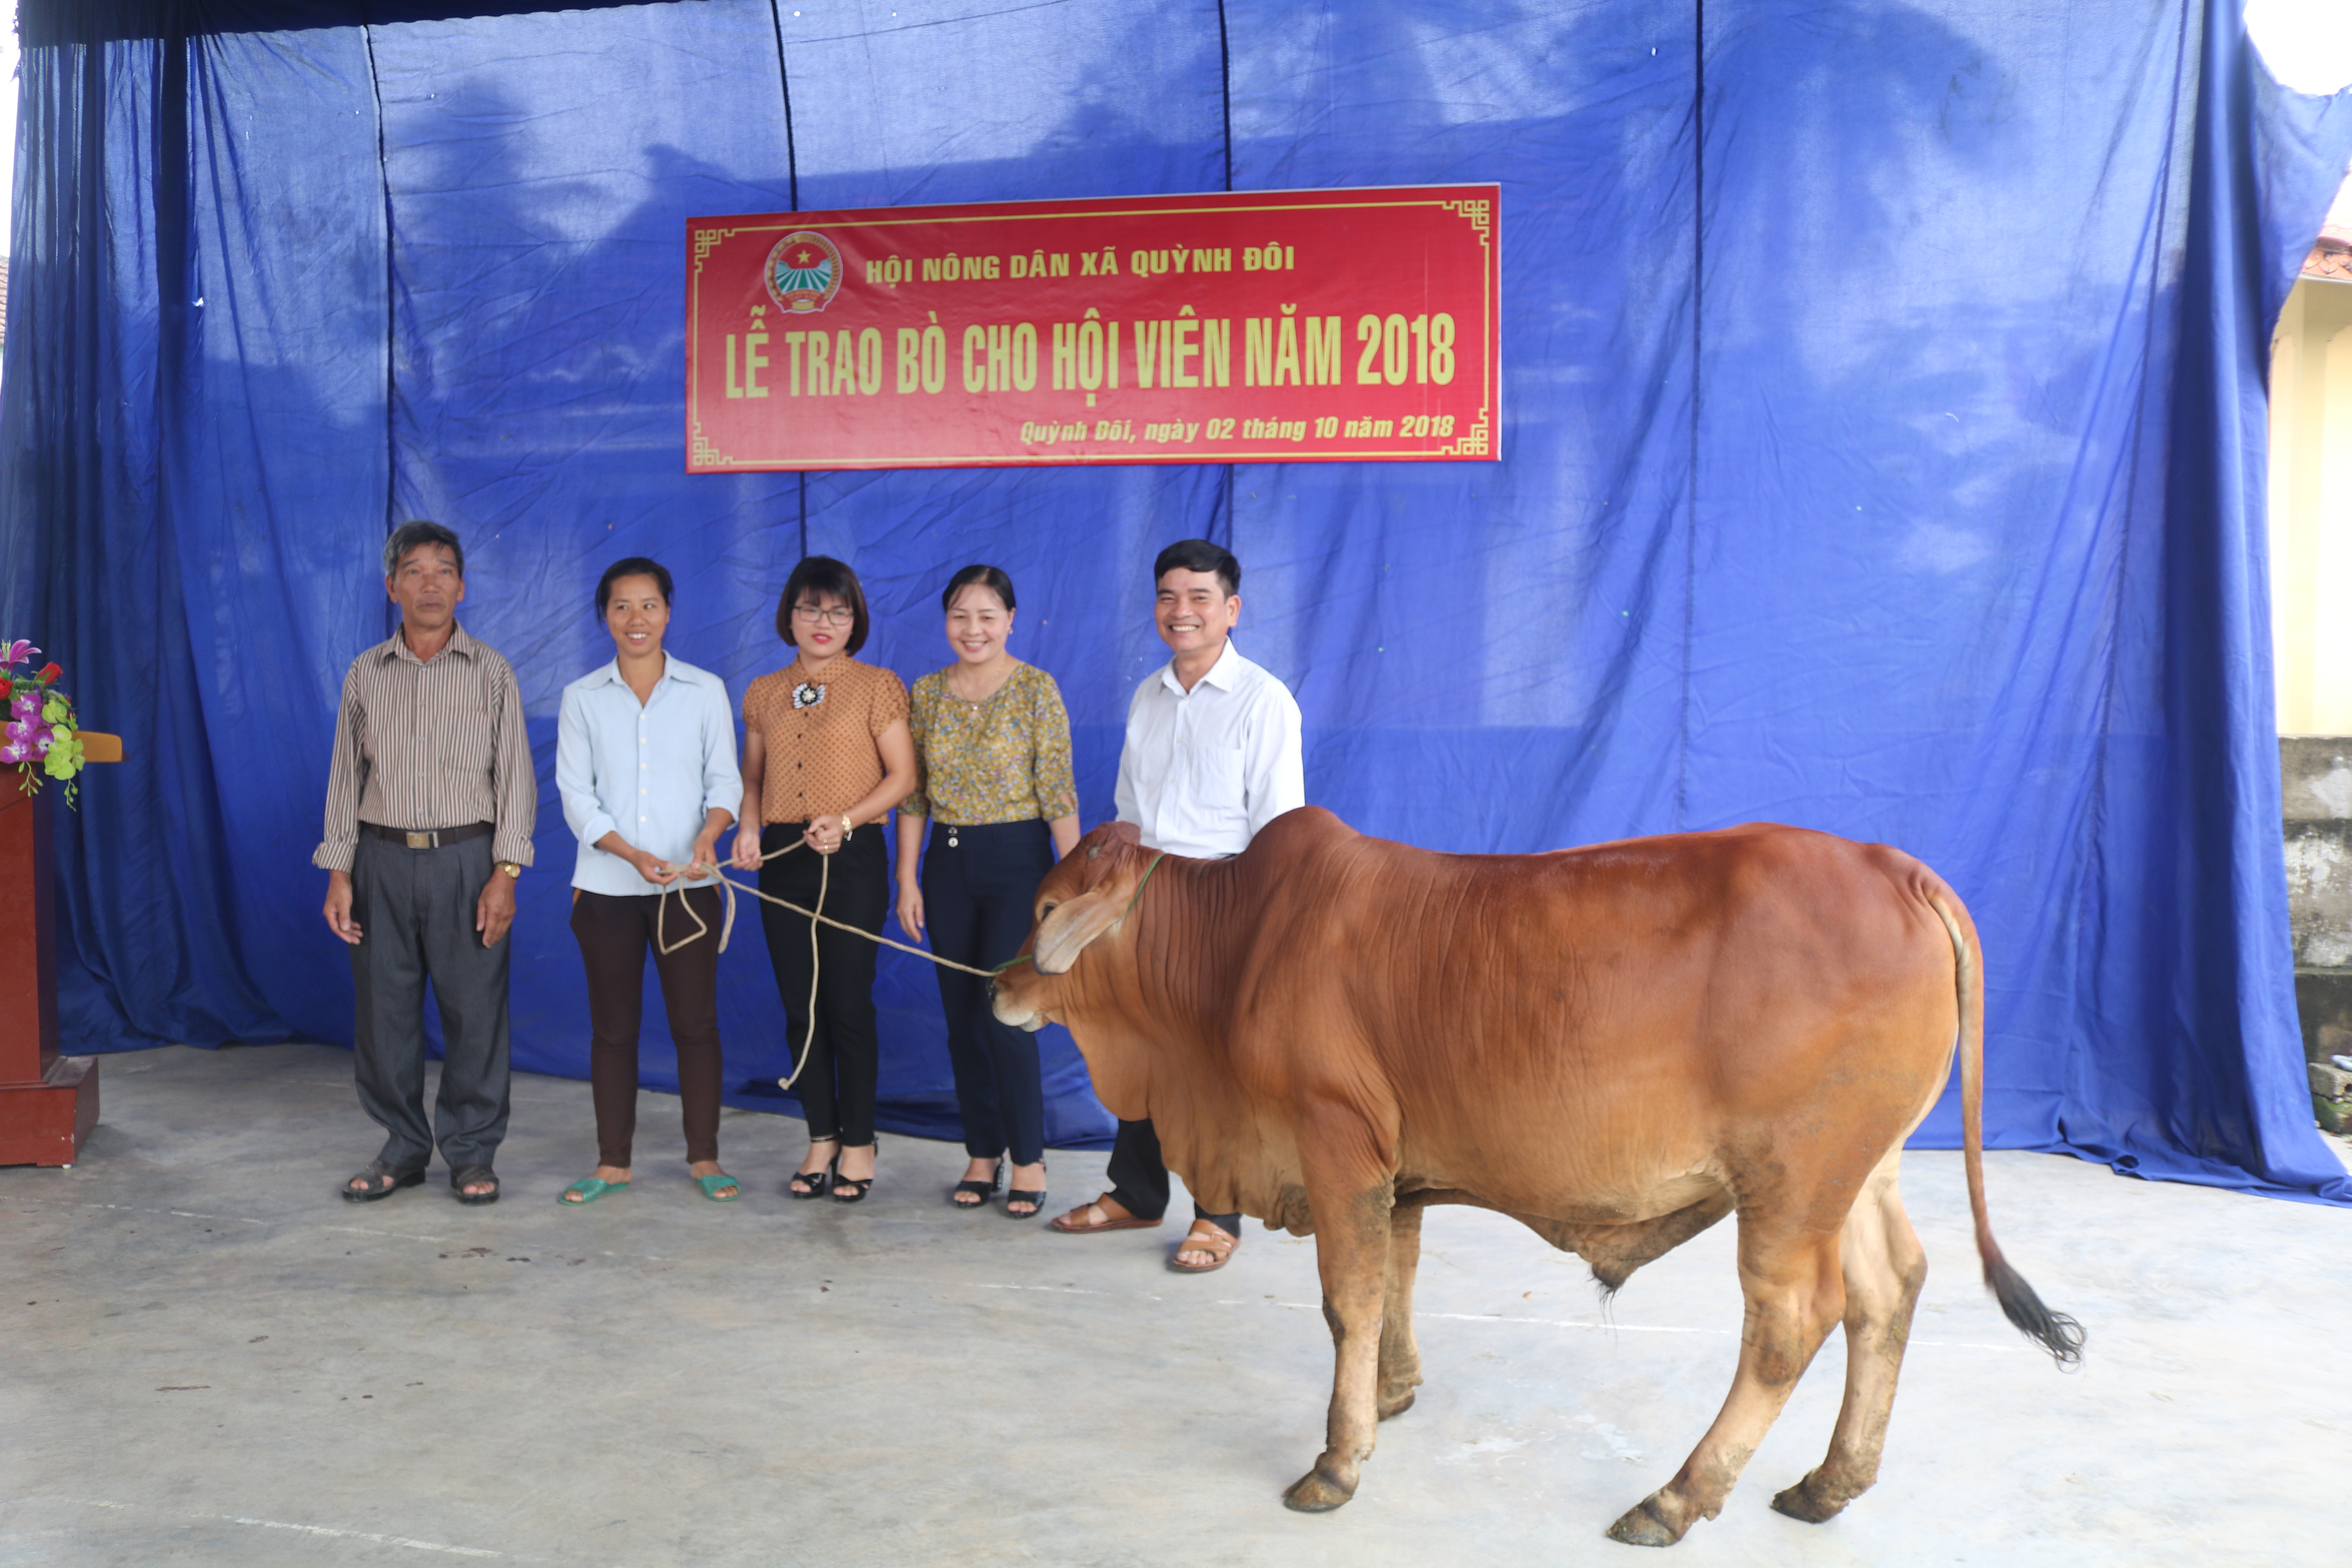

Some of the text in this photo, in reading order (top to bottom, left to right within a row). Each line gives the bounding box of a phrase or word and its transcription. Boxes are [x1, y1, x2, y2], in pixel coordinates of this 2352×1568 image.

[867, 241, 1294, 288] HỘI NÔNG DÂN XÃ QUỲNH ĐÔI
[726, 303, 1455, 407] LỄ TRAO BÒ CHO HỘI VIÊN NĂM 2018
[1020, 415, 1455, 445] Quỳnh Đôi, ngày 02 tháng 10 năm 2018
